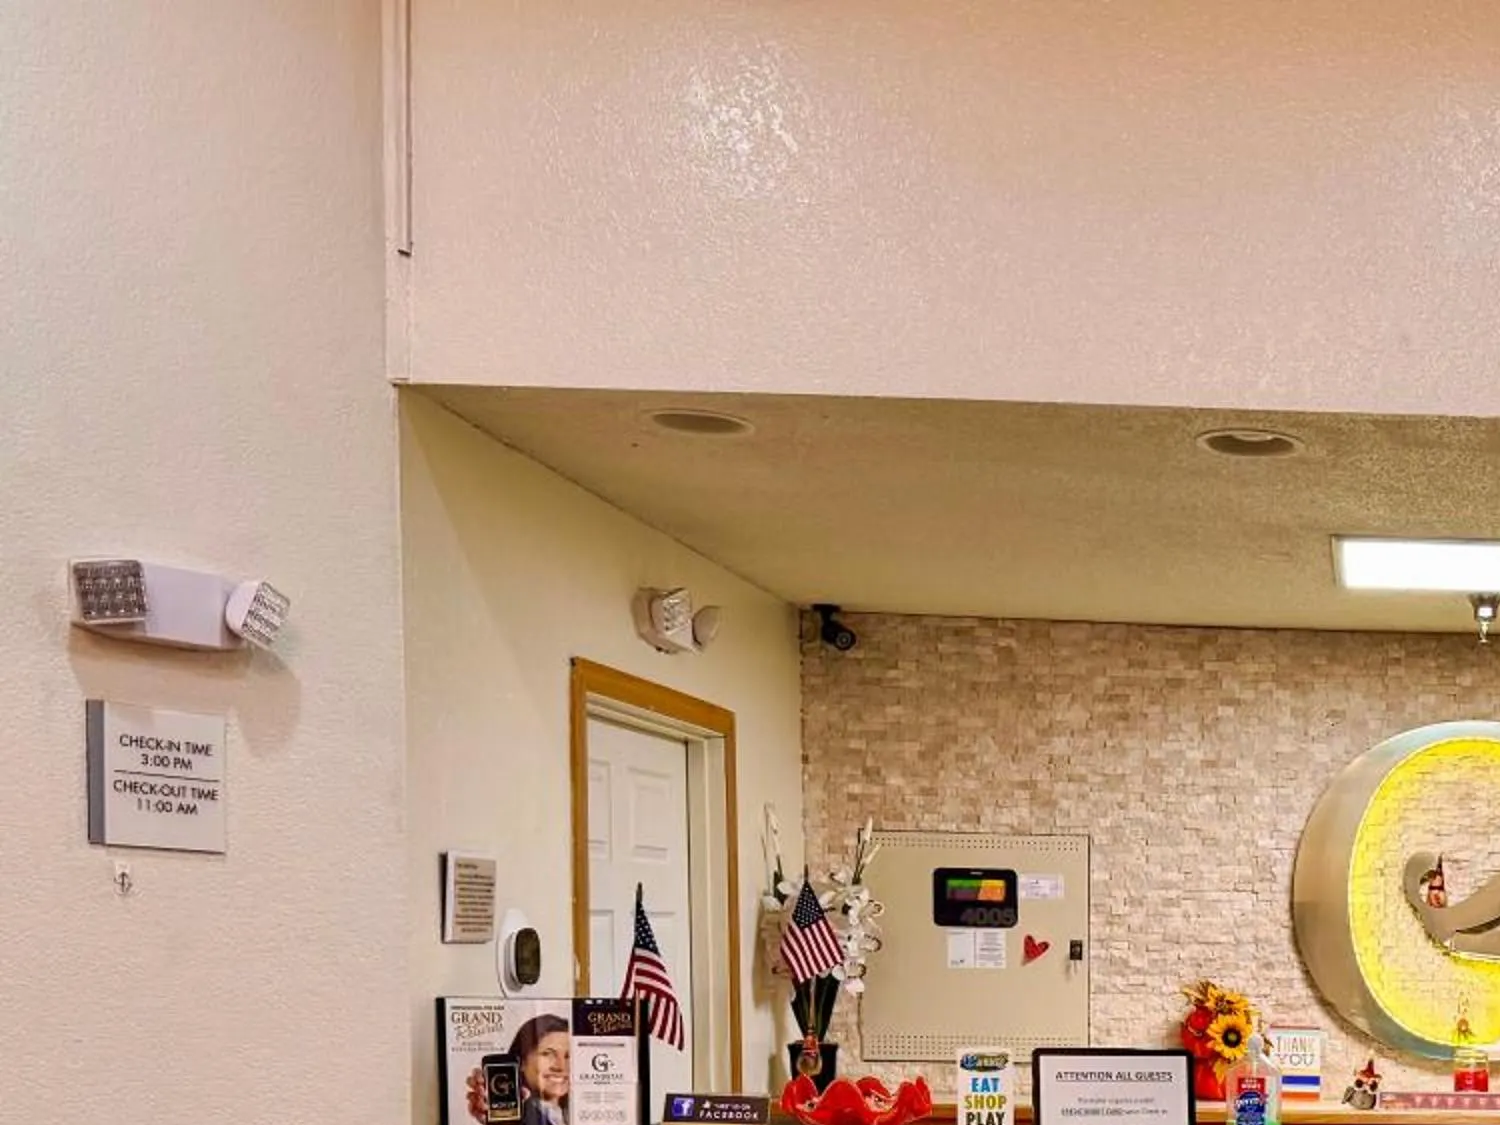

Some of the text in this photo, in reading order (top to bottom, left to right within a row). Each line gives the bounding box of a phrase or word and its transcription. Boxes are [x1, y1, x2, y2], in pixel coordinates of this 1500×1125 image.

[119, 734, 213, 757] CHECK-IN TIME
[141, 753, 193, 770] 3:00 PM
[113, 779, 220, 801] CHECK-OUT TIME
[137, 797, 198, 815] 11:00 AM
[451, 1011, 503, 1024] GRAND
[1276, 1035, 1314, 1052] THANK
[1275, 1053, 1315, 1066] YOU
[1056, 1071, 1173, 1082] ATTENTION ALL GUESTS
[971, 1077, 1000, 1093] EAT
[964, 1095, 1007, 1110] SHOP
[700, 1110, 759, 1120] FACEBOOK
